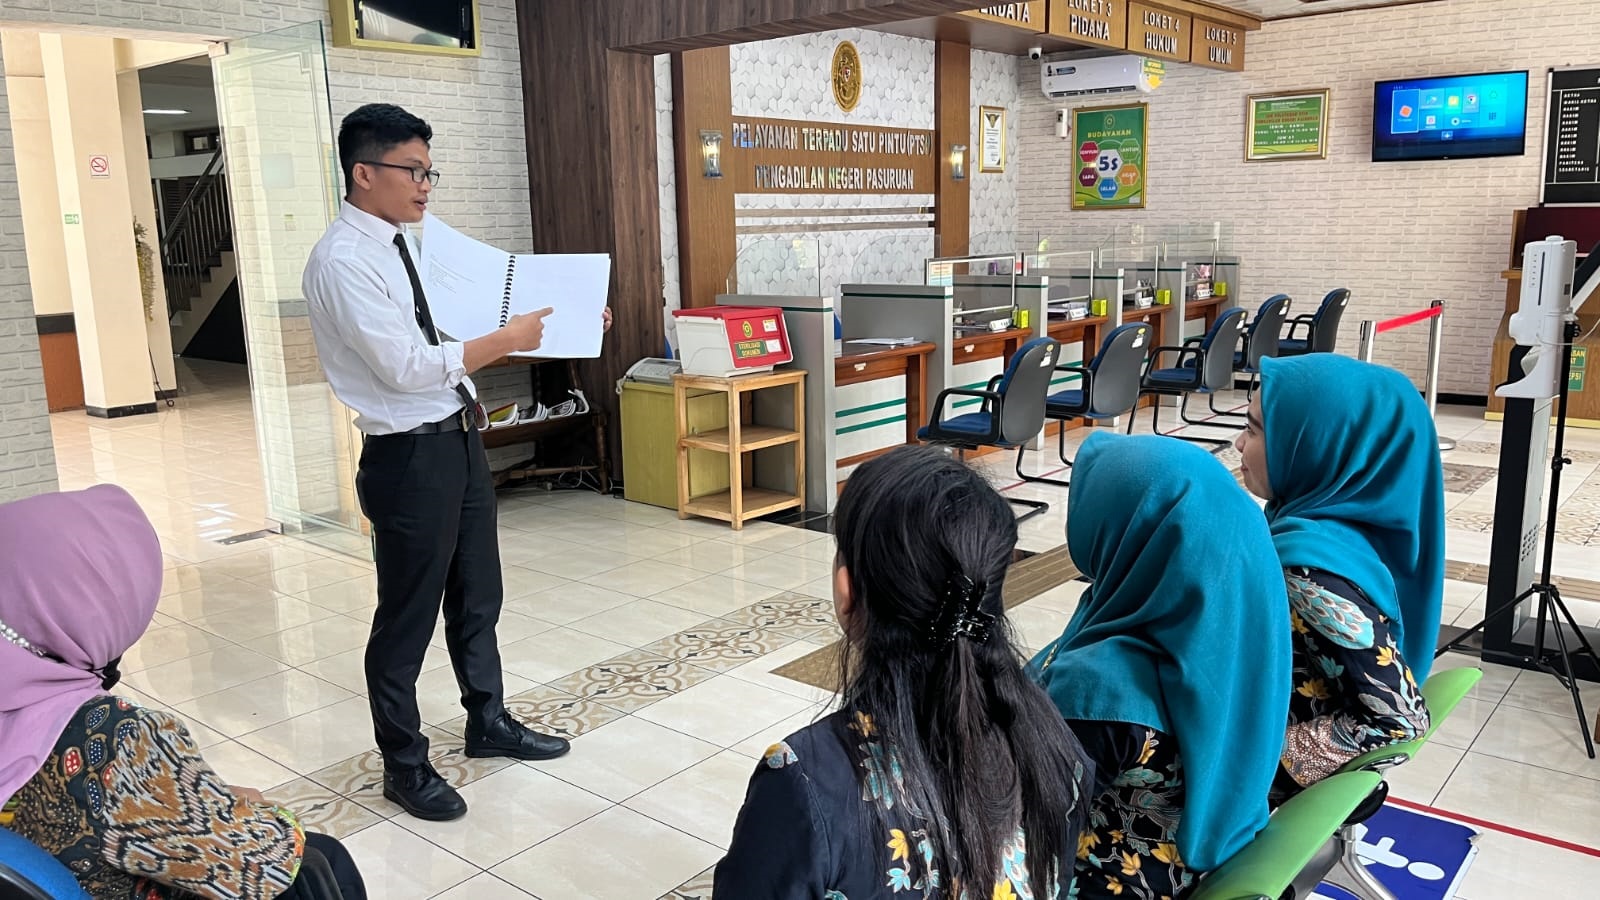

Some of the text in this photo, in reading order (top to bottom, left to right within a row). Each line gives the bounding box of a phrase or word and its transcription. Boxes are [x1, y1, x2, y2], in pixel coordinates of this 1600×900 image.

[1106, 2, 1112, 17] 3
[1070, 14, 1110, 41] PIDANA
[1144, 10, 1180, 33] LOKET 4
[1145, 31, 1177, 55] HUKUM
[1206, 25, 1237, 46] LOKET 5
[1209, 45, 1232, 65] UMUM
[732, 122, 798, 150] PELAYANAN
[802, 127, 848, 153] TERPADU
[852, 130, 875, 153] SATU
[1087, 129, 1132, 138] BUDAYAKAN
[755, 164, 914, 190] PENGADILAN NEGERI PASURUAN
